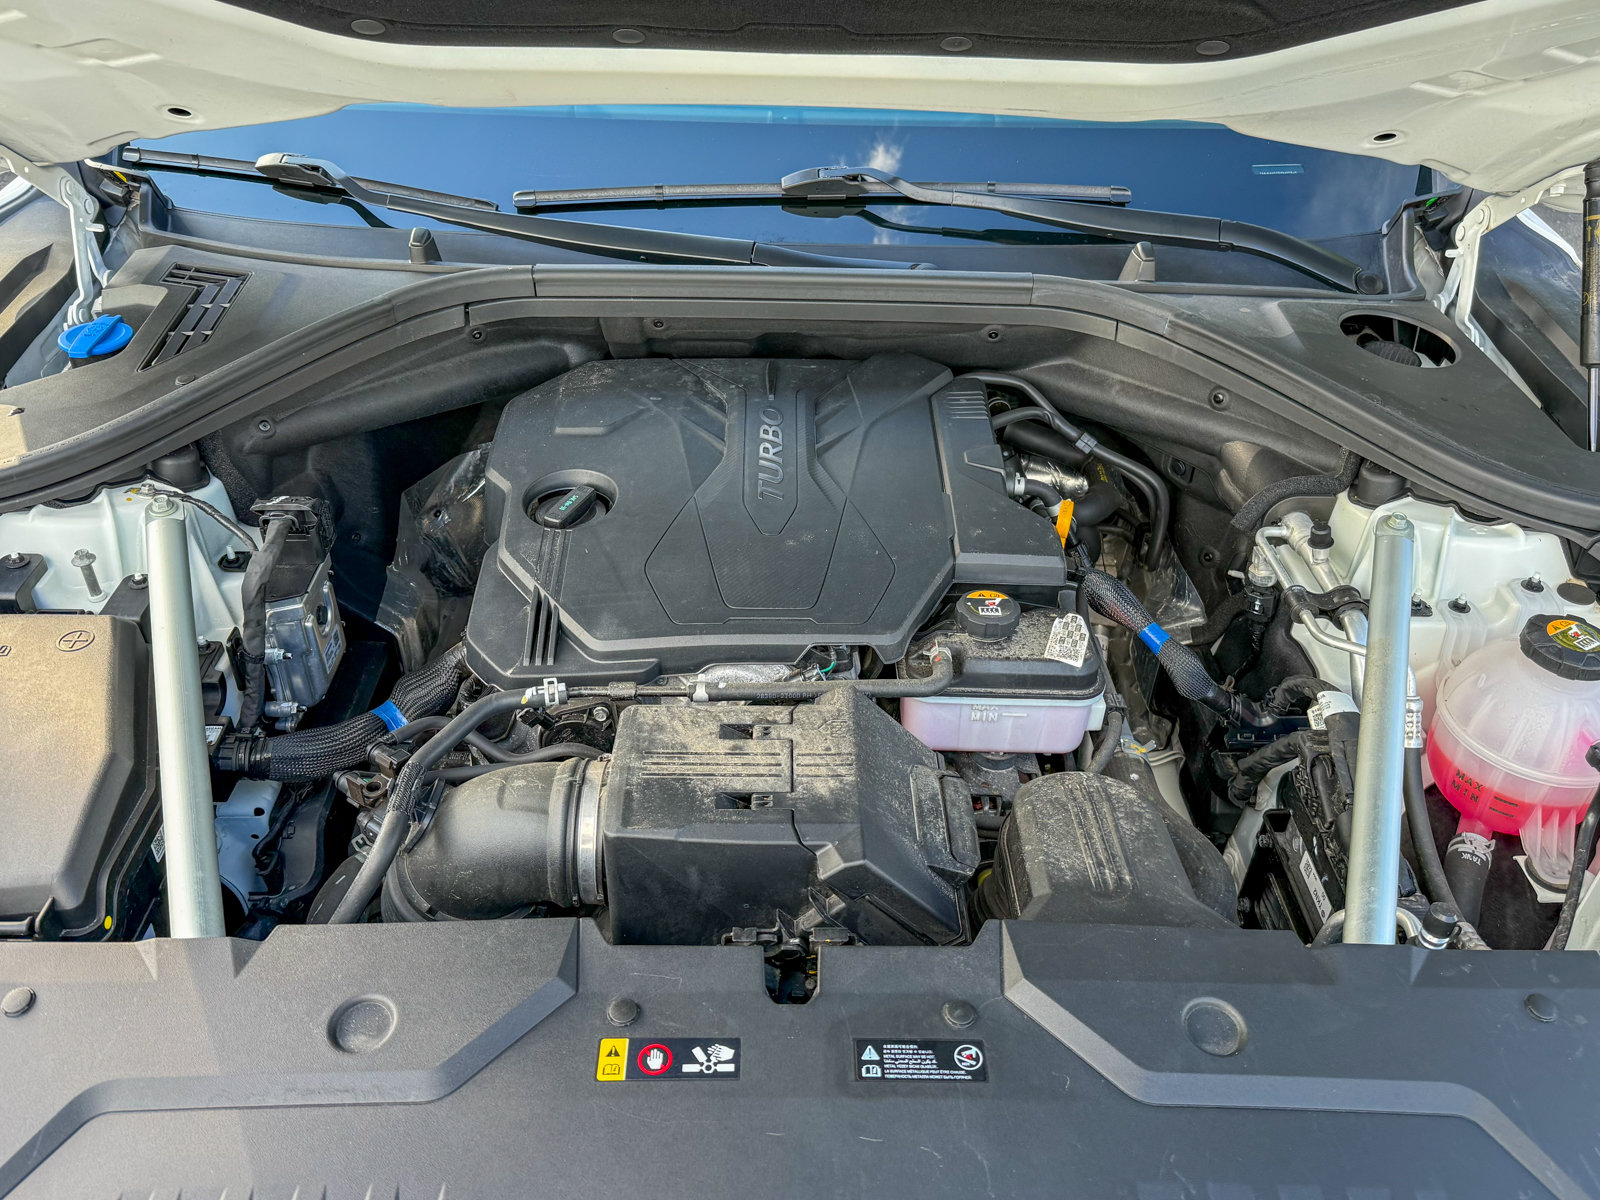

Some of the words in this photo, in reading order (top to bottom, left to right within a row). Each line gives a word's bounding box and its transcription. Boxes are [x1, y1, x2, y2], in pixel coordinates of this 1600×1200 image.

[758, 406, 784, 500] TURBO
[971, 710, 998, 722] MIN
[1451, 780, 1479, 803] MIN
[1455, 769, 1484, 792] MAX
[1461, 852, 1482, 866] TANK
